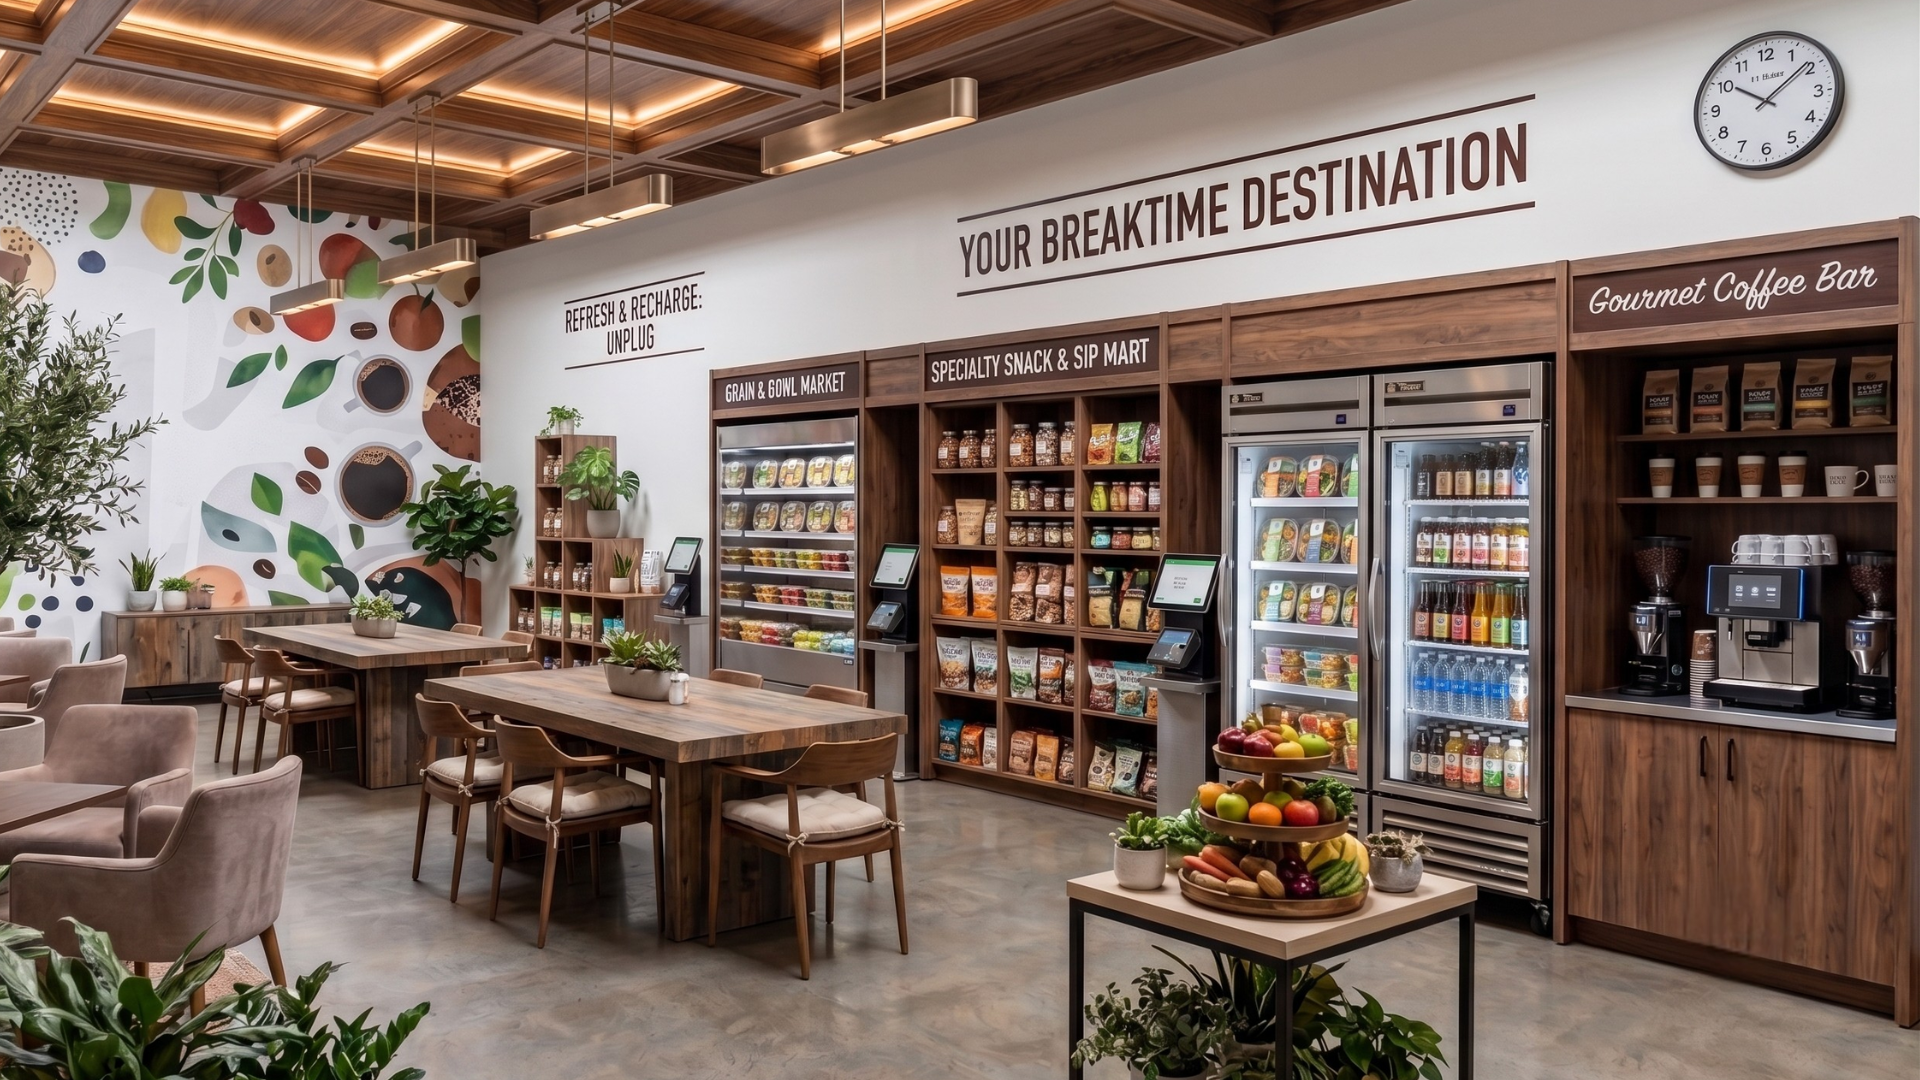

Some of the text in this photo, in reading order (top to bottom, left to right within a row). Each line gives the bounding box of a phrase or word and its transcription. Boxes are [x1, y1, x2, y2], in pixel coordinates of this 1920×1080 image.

[1757, 48, 1774, 62] 12
[1787, 49, 1794, 62] 1
[1735, 60, 1748, 73] 11
[1805, 62, 1816, 75] 2
[1717, 79, 1734, 94] 10
[1813, 84, 1824, 97] 3
[1711, 105, 1721, 118] 9
[1805, 110, 1816, 123] 4
[1718, 126, 1729, 139] 8
[1787, 131, 1797, 144] 5
[1737, 140, 1747, 153] 7
[1761, 142, 1772, 155] 6
[959, 122, 1528, 278] YOUR BREAKTIME DESTINATION
[1589, 260, 1878, 315] Gourmet Coffee Bar
[565, 283, 702, 334] REFRESH & RECHARGE:
[607, 323, 655, 356] UNPLUG
[931, 337, 1150, 384] SPECIALTY SNACK & SIP MART
[725, 371, 846, 403] GRAIN & GOWL MARKET
